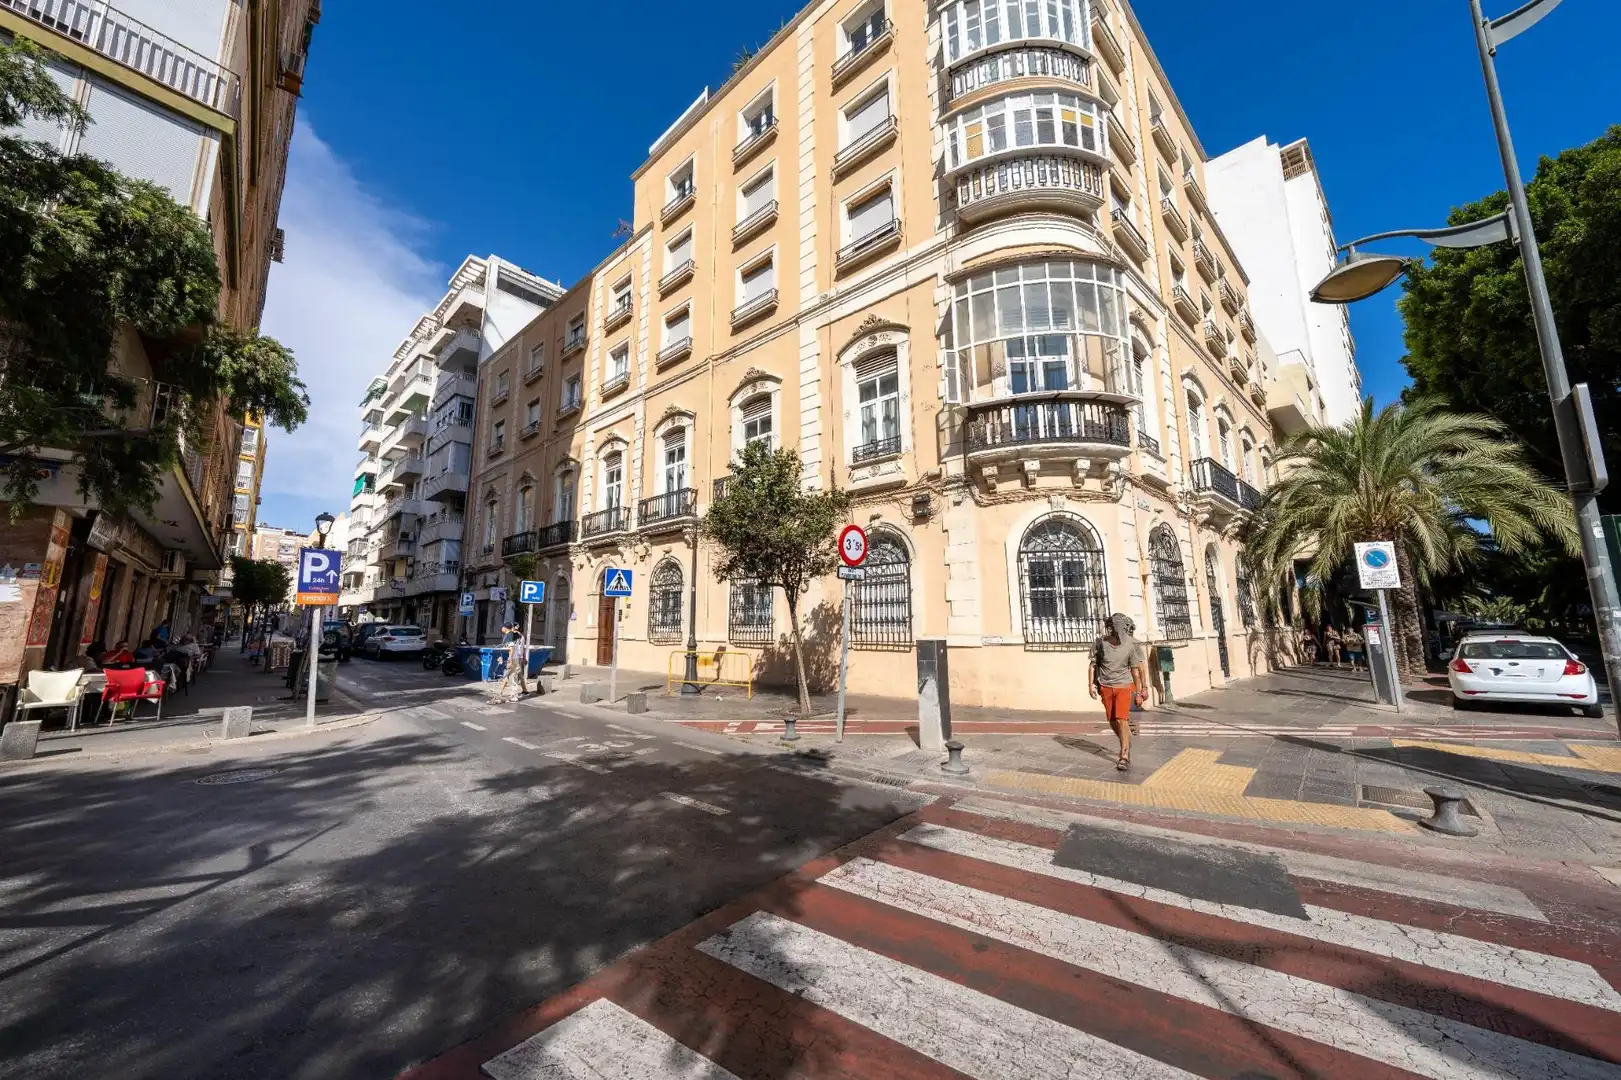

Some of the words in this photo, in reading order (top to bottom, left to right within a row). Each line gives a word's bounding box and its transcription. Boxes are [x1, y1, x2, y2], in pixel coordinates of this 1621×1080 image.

[303, 552, 329, 583] P
[524, 584, 538, 599] P
[463, 594, 473, 605] P
[1367, 609, 1376, 618] P
